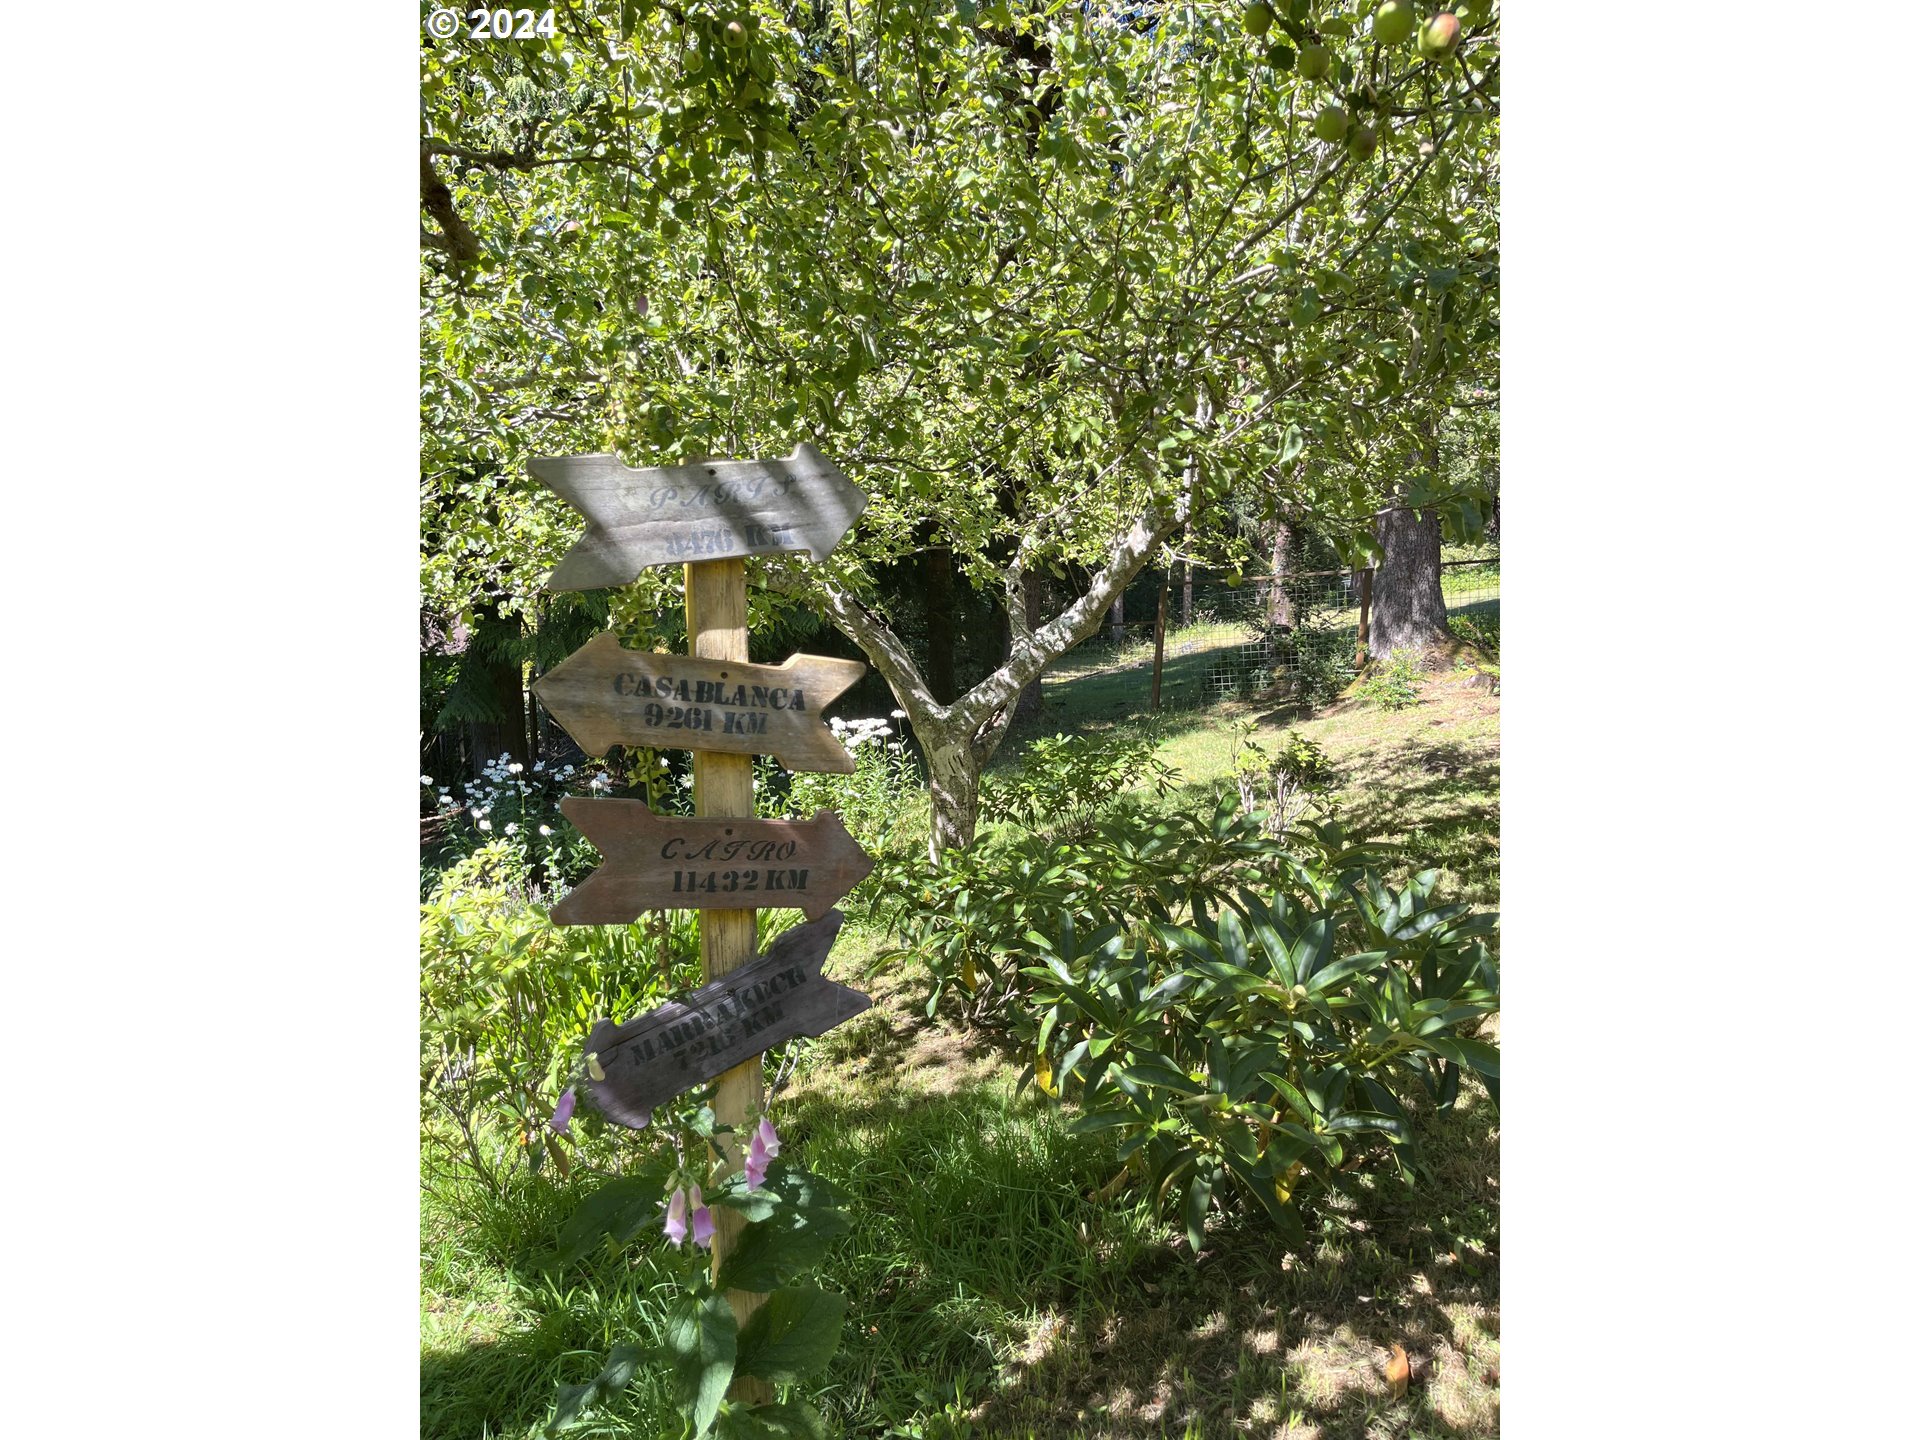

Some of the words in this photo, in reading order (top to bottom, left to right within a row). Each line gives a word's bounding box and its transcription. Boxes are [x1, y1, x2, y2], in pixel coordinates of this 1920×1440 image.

[650, 474, 796, 511] PARIS
[744, 522, 795, 547] KM
[613, 672, 806, 711] CASABLANCA
[644, 702, 713, 731] 9261
[723, 711, 768, 735] KM
[660, 837, 797, 862] CAIRO
[672, 869, 759, 894] 11432
[765, 868, 810, 892] KM
[630, 966, 808, 1067] MARRAKECH
[742, 1001, 785, 1038] KM
